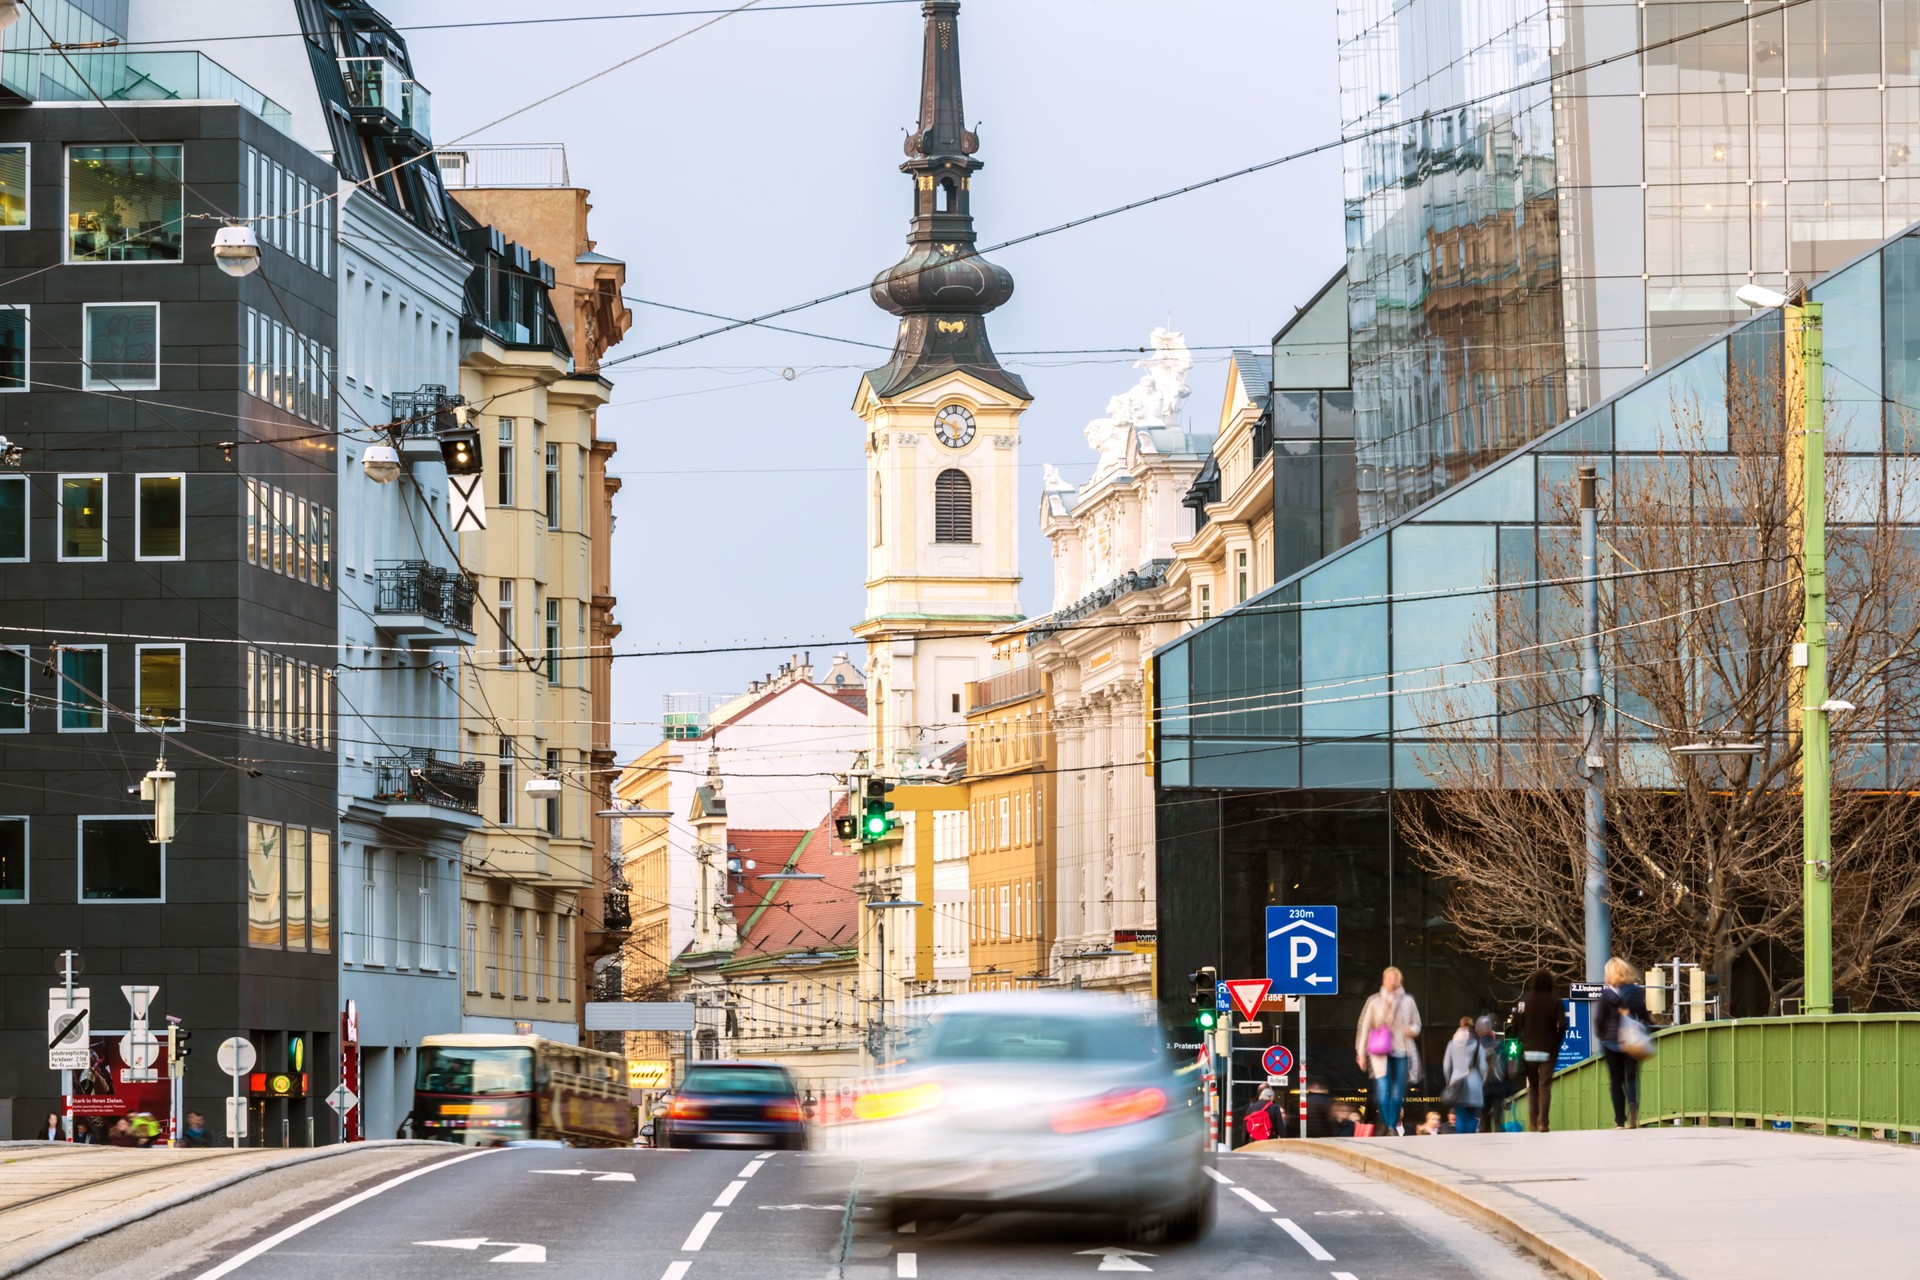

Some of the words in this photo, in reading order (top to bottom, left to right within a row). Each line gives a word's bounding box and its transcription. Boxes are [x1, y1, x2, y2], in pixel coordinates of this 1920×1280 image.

[1288, 909, 1315, 919] 230m
[1290, 936, 1318, 978] P
[1565, 1030, 1582, 1039] TAL
[1173, 1042, 1203, 1050] Praterst
